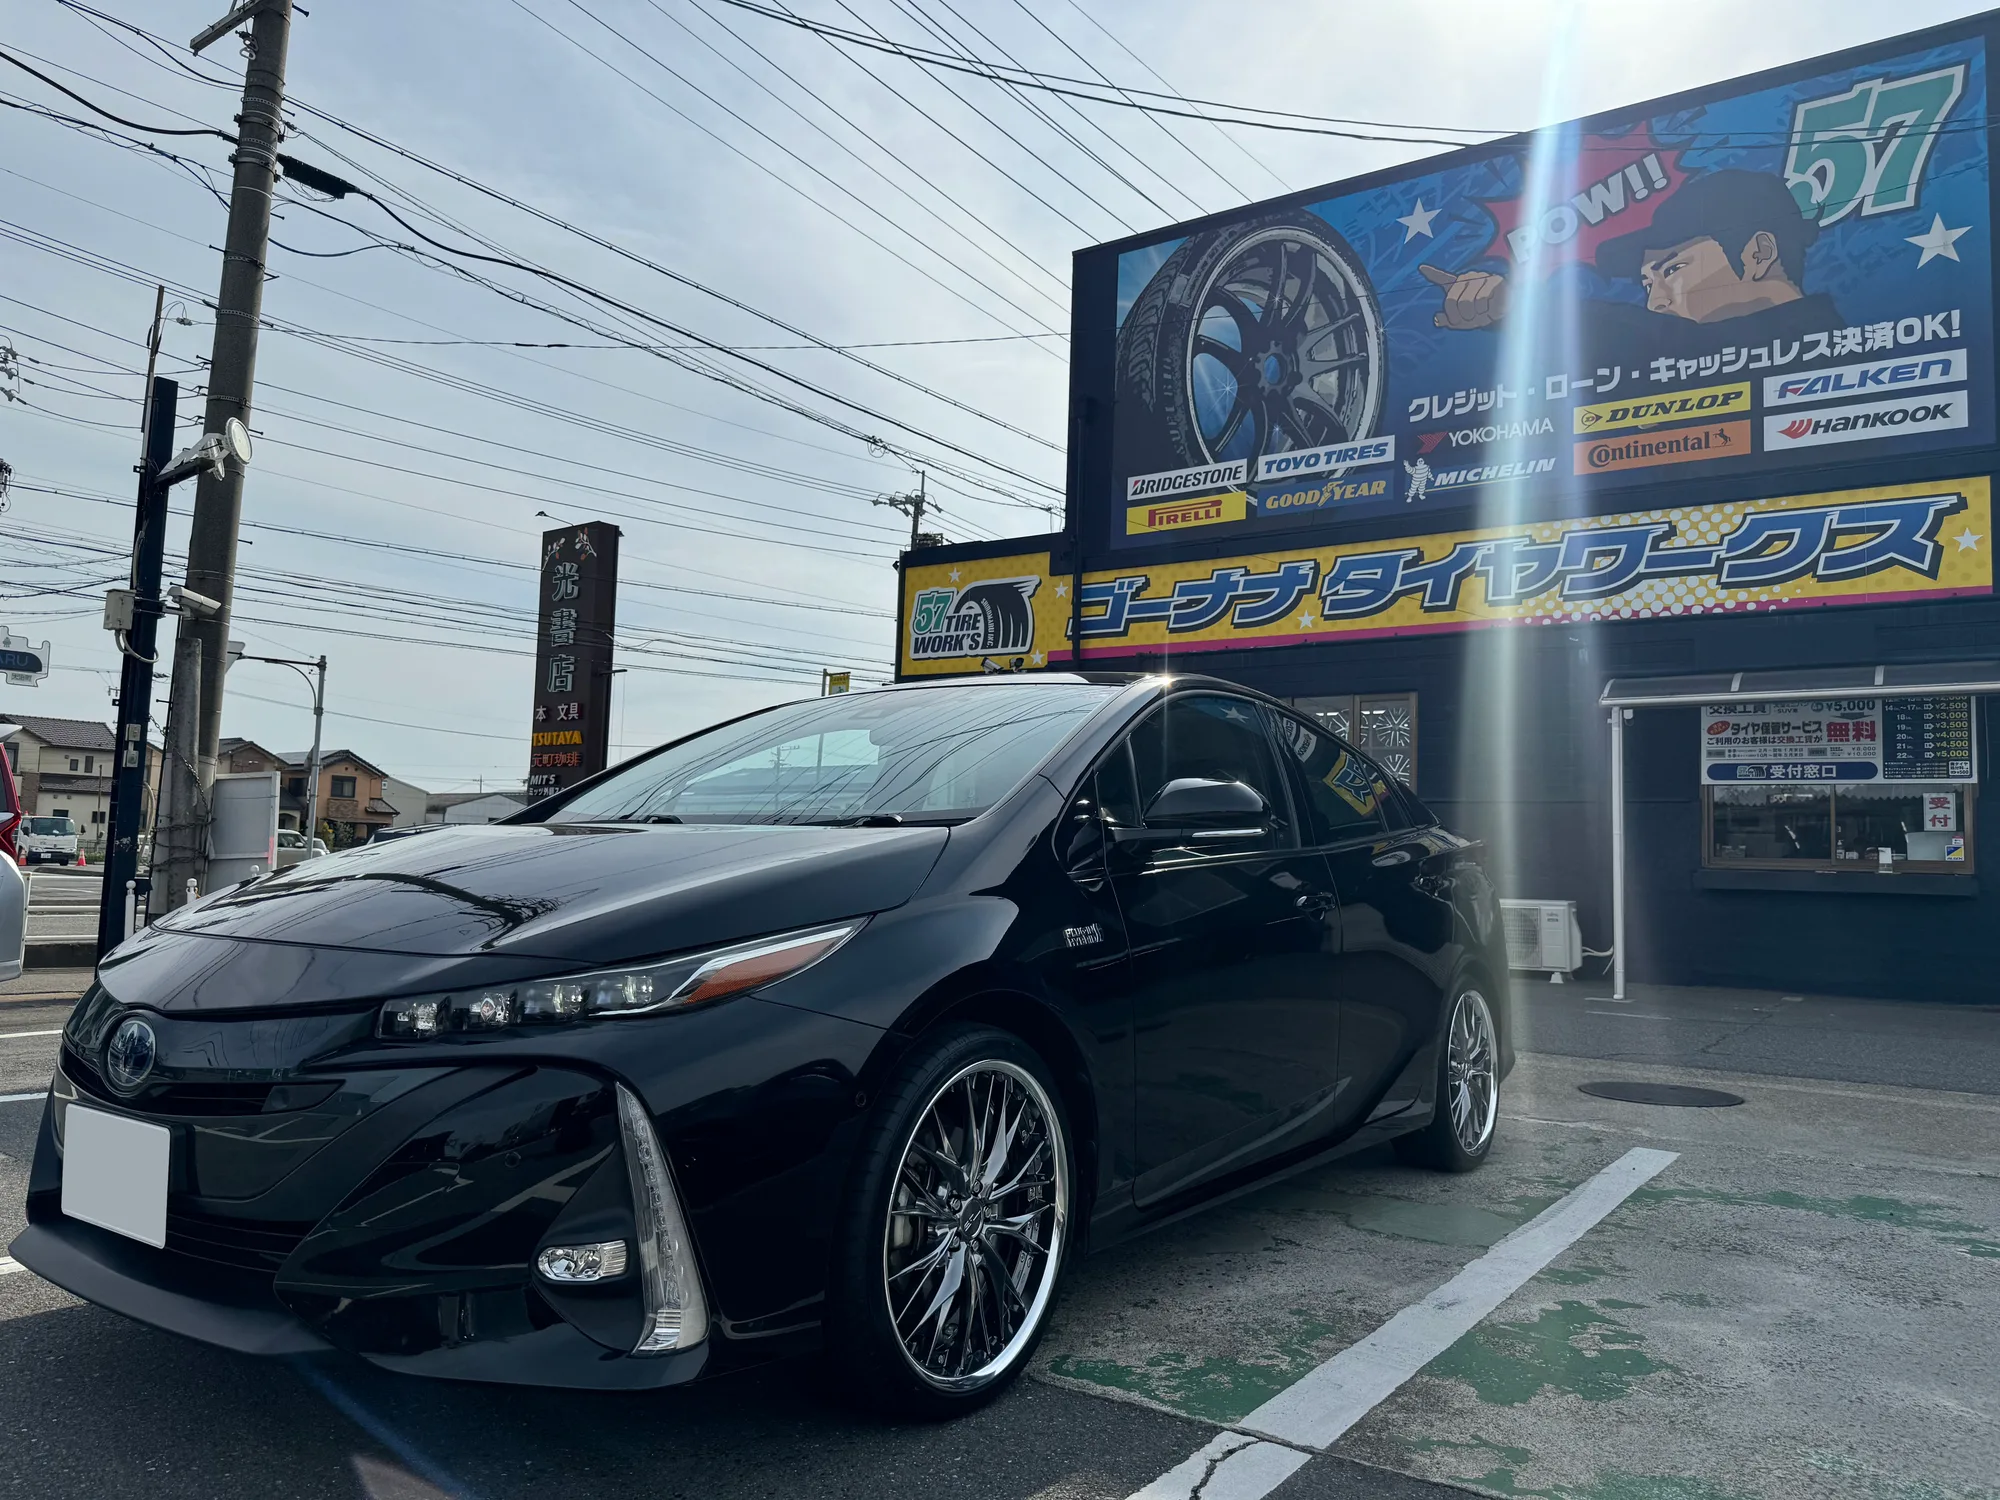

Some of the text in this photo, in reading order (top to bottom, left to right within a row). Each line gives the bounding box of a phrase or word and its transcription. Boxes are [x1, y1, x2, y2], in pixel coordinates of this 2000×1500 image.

[1785, 63, 1967, 228] 57
[1505, 152, 1671, 265] POW!!
[1778, 359, 1952, 399] FALKEN
[1606, 390, 1743, 422] DUNLOP
[1448, 418, 1554, 447] YOKOHAMA
[1264, 442, 1389, 474] TOYO TIRES
[1588, 431, 1710, 467] Continental
[1131, 465, 1244, 496] BRIDGESTONE
[1434, 458, 1556, 486] MICHELIN
[1148, 499, 1223, 527] PIRELLI
[547, 561, 580, 692] 光書店
[913, 590, 982, 635] 57 TIRE
[913, 633, 982, 654] WORK'S
[535, 703, 579, 722] 本 文具
[533, 731, 582, 747] TSUTAYA
[1826, 720, 1876, 742] 無料
[531, 752, 581, 768] 元町珈琲
[1770, 765, 1836, 778] 受付窓口
[1928, 797, 1952, 828] 受付
